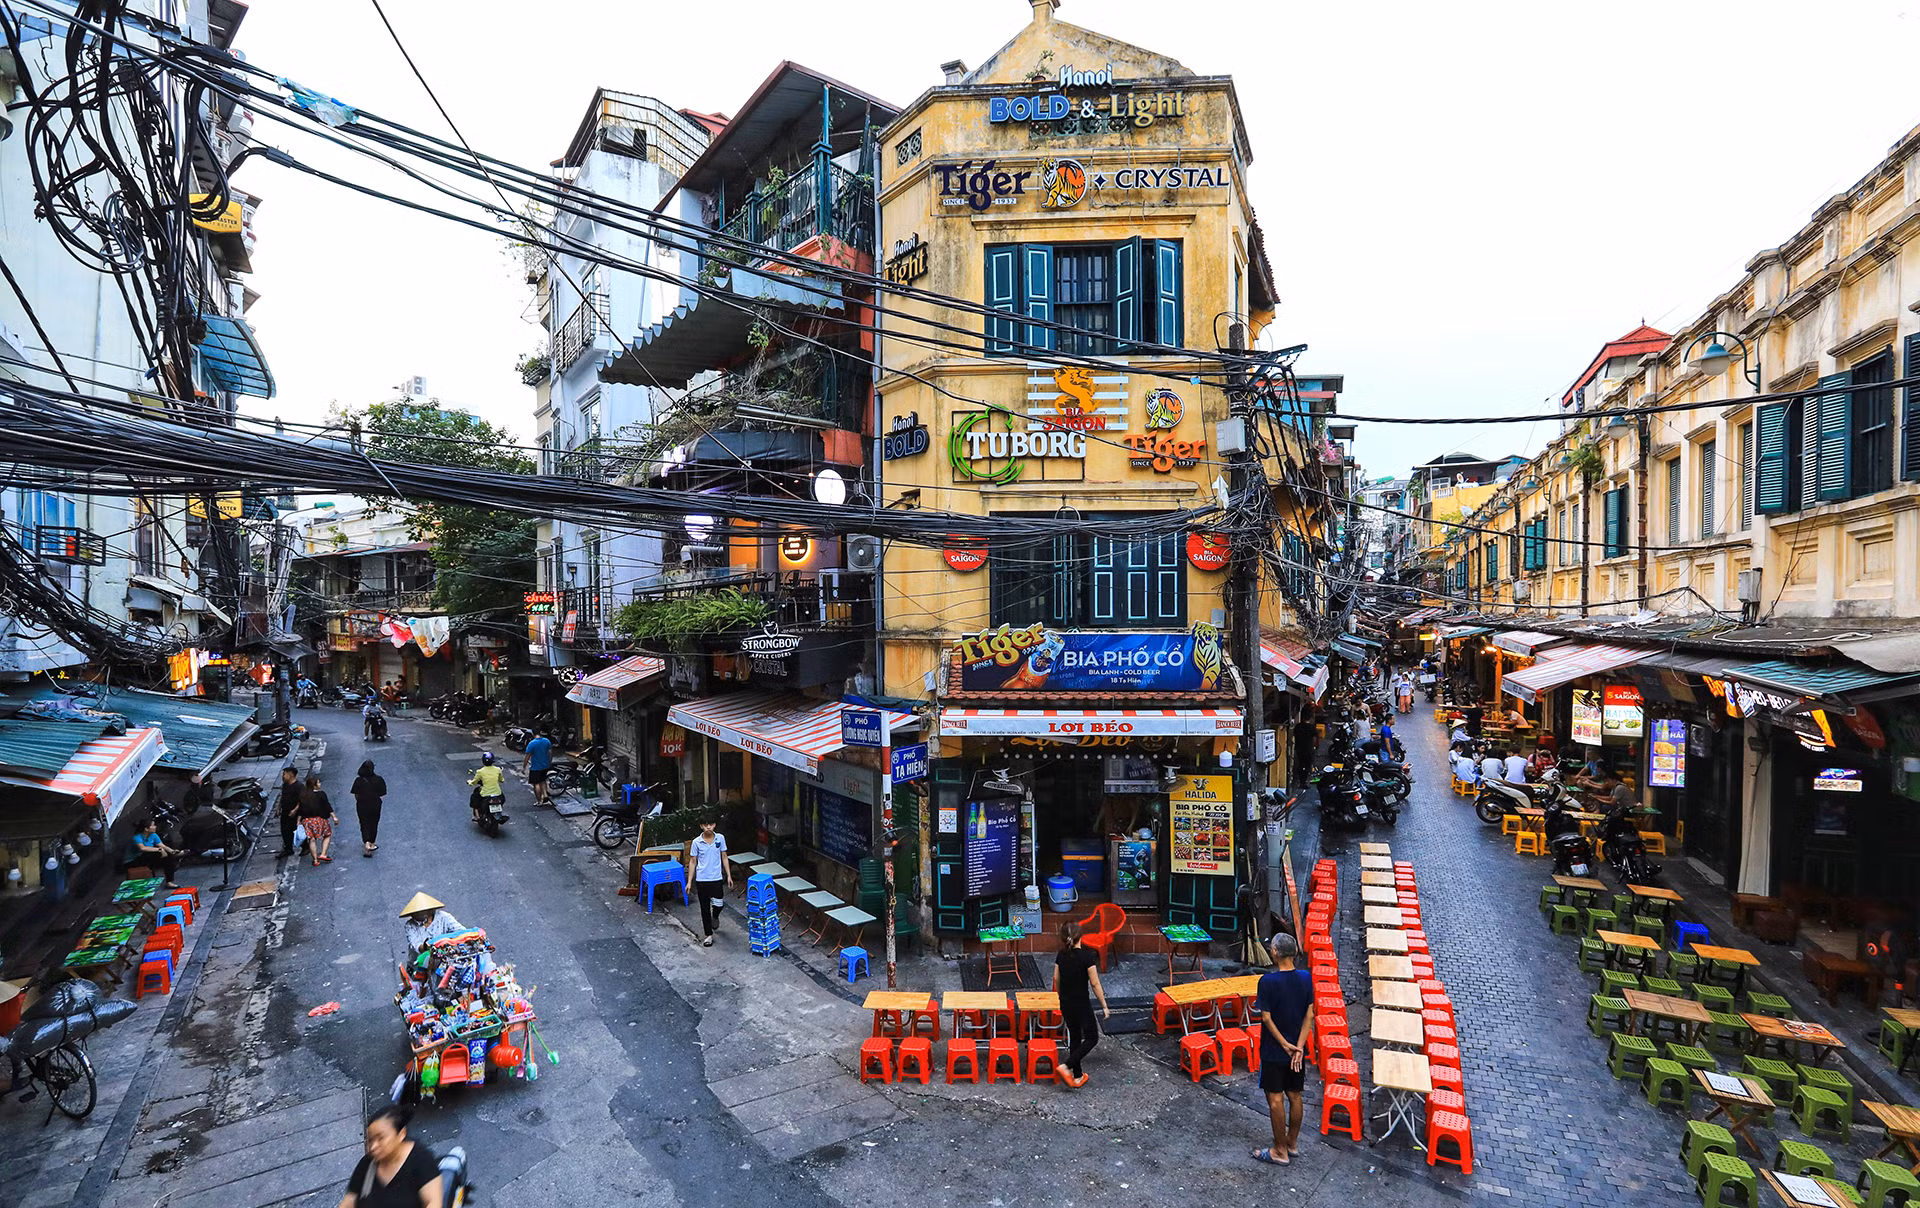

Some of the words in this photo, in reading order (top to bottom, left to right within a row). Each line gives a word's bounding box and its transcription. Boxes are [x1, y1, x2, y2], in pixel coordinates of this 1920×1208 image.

[1059, 63, 1113, 88] Hanoi
[990, 94, 1070, 123] BOLD
[1081, 100, 1096, 118] &
[1110, 90, 1185, 127] Light
[934, 159, 1031, 211] Tiger
[1115, 168, 1230, 190] CRYSTAL
[944, 198, 964, 206] SINCE
[894, 232, 918, 258] Hanoi
[1066, 408, 1084, 416] BIA
[892, 411, 916, 432] Hanoi
[1043, 416, 1106, 431] SAIGON
[884, 428, 927, 461] BOLD
[966, 430, 1086, 460] TUBORG
[1124, 430, 1206, 472] Tiger
[1193, 554, 1223, 562] SAIGON
[742, 638, 800, 650] STRONGBOW
[952, 621, 1047, 667] Tiger
[1063, 651, 1099, 667] BIA
[1103, 645, 1150, 667] PHỐ
[1154, 644, 1184, 667] CỔ
[754, 659, 788, 676] CRYSTAL
[972, 659, 994, 671] SINCE
[855, 716, 868, 725] PHỐ
[1048, 722, 1084, 735] LỢI
[1091, 720, 1133, 733] BÉO
[663, 744, 681, 754] 10K
[756, 743, 772, 756] BÉO
[903, 749, 916, 760] PHỐ
[896, 765, 905, 779] TẠ
[906, 759, 924, 776] HIỆN
[1185, 791, 1217, 799] HALIDA
[1192, 803, 1210, 811] PHỐ
